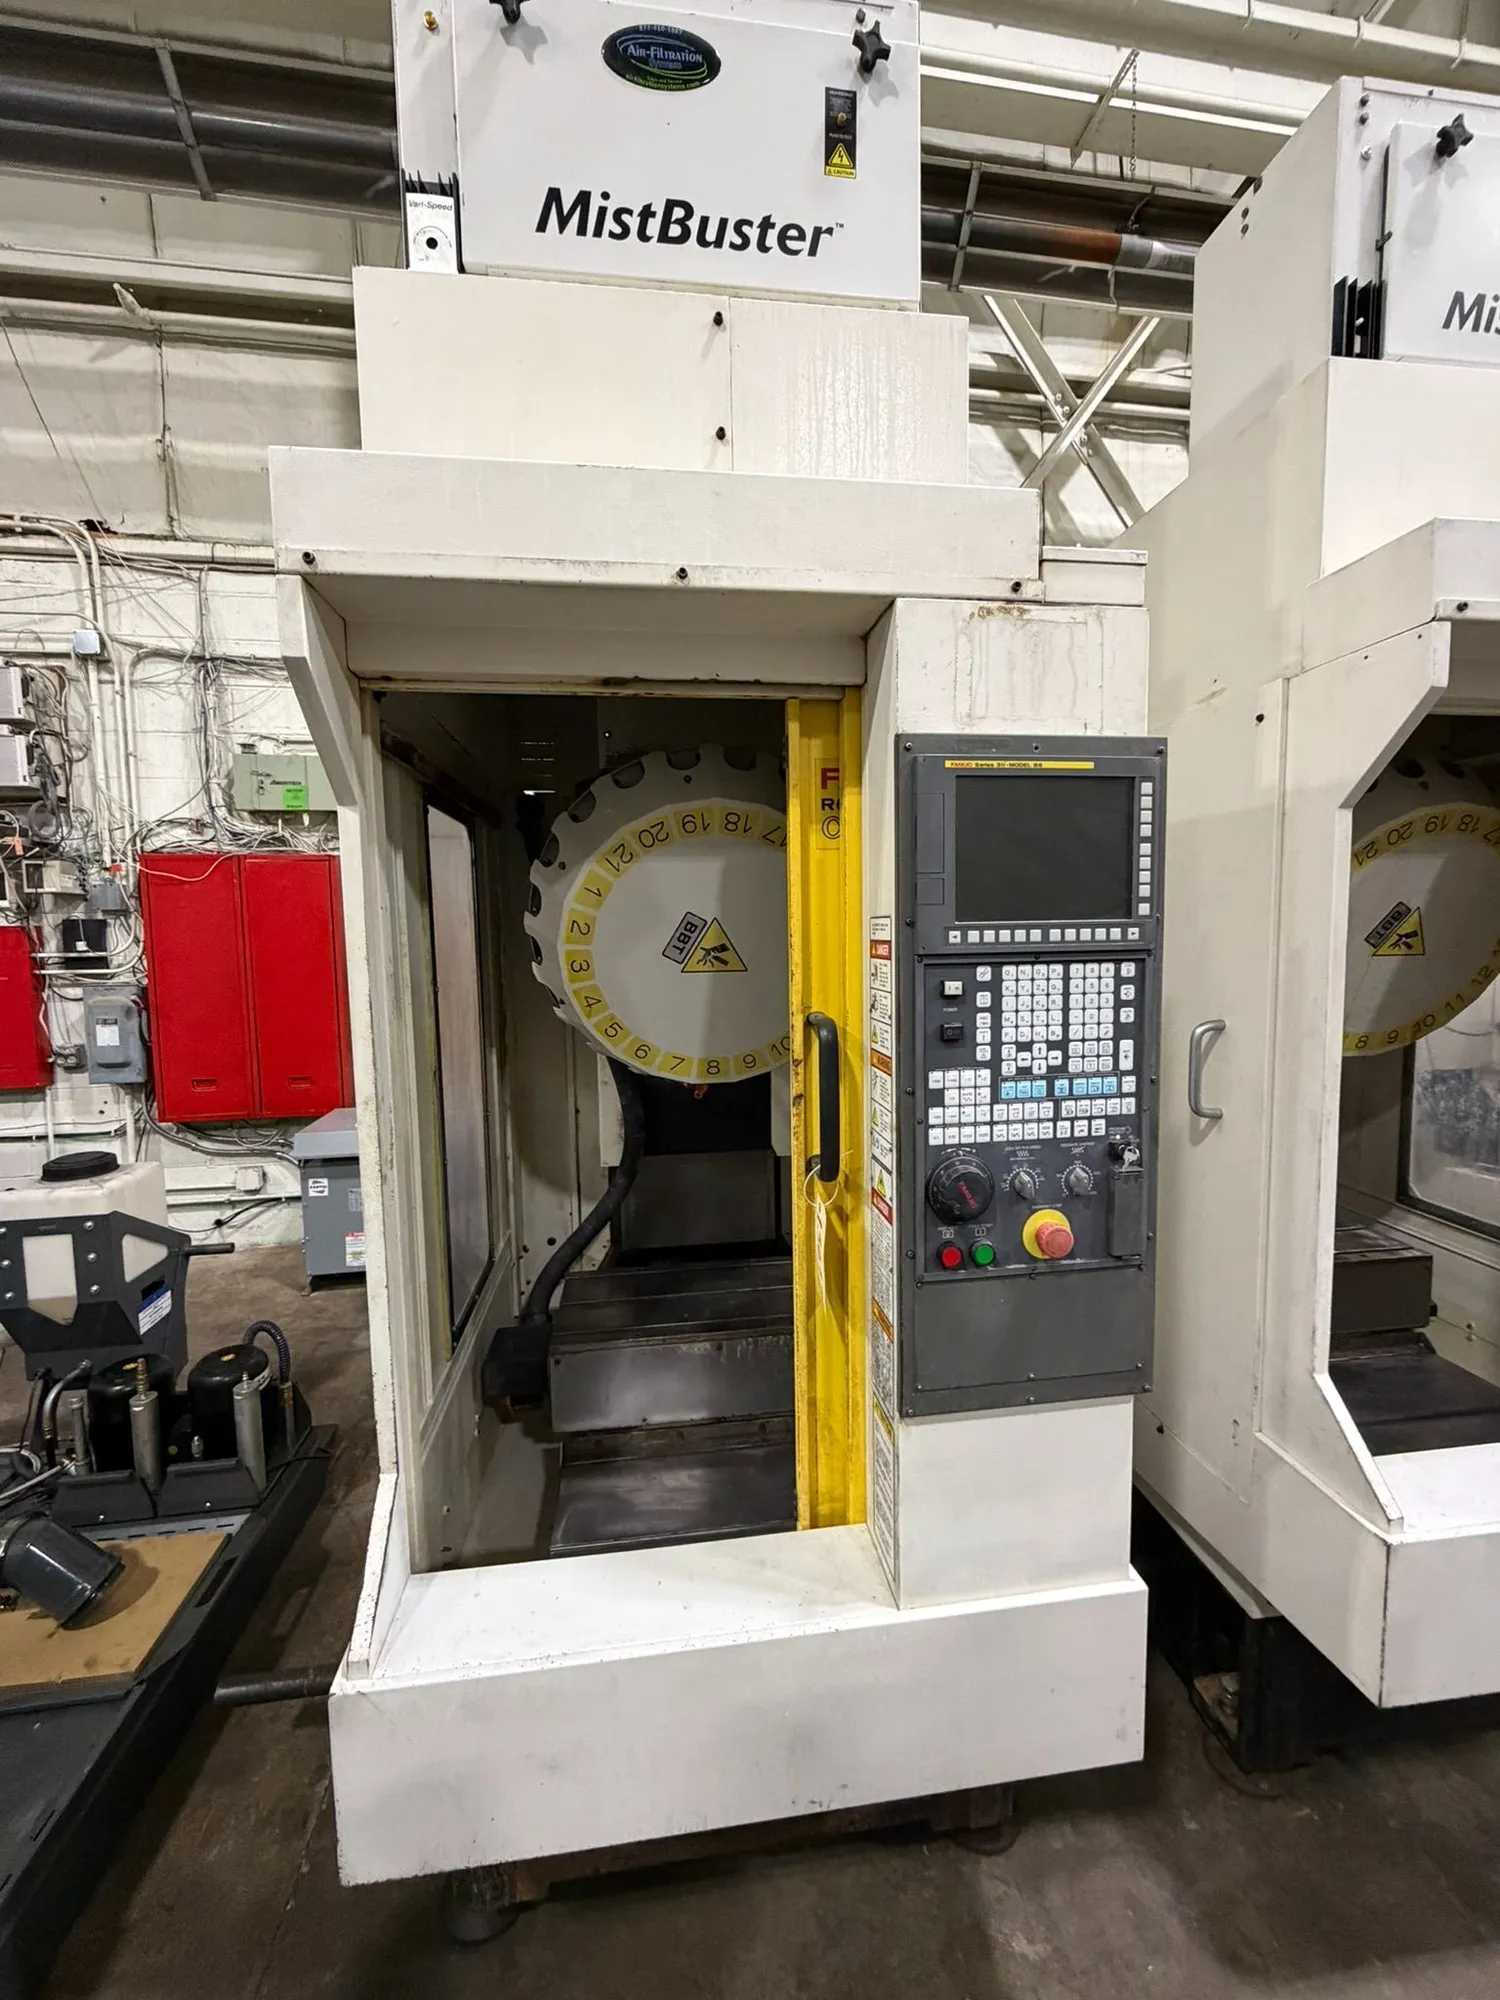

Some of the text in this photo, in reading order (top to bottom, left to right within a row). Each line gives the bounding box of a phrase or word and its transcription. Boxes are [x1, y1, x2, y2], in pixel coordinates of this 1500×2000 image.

[681, 813, 711, 835] 19
[724, 812, 753, 834] 18
[1424, 815, 1449, 834] 19
[1457, 813, 1481, 834] 18
[638, 820, 669, 848] 20
[1385, 820, 1415, 846] 20
[605, 843, 634, 873] 21
[1353, 840, 1379, 867] 21
[570, 919, 591, 936] 2
[672, 920, 699, 956] BBT
[570, 959, 590, 973] 3
[583, 995, 602, 1009] 4
[604, 1021, 624, 1039] 5
[1355, 1034, 1370, 1049] 8
[634, 1043, 652, 1060] 6
[669, 1055, 686, 1071] 7
[706, 1059, 721, 1076] 8
[742, 1054, 757, 1070] 9
